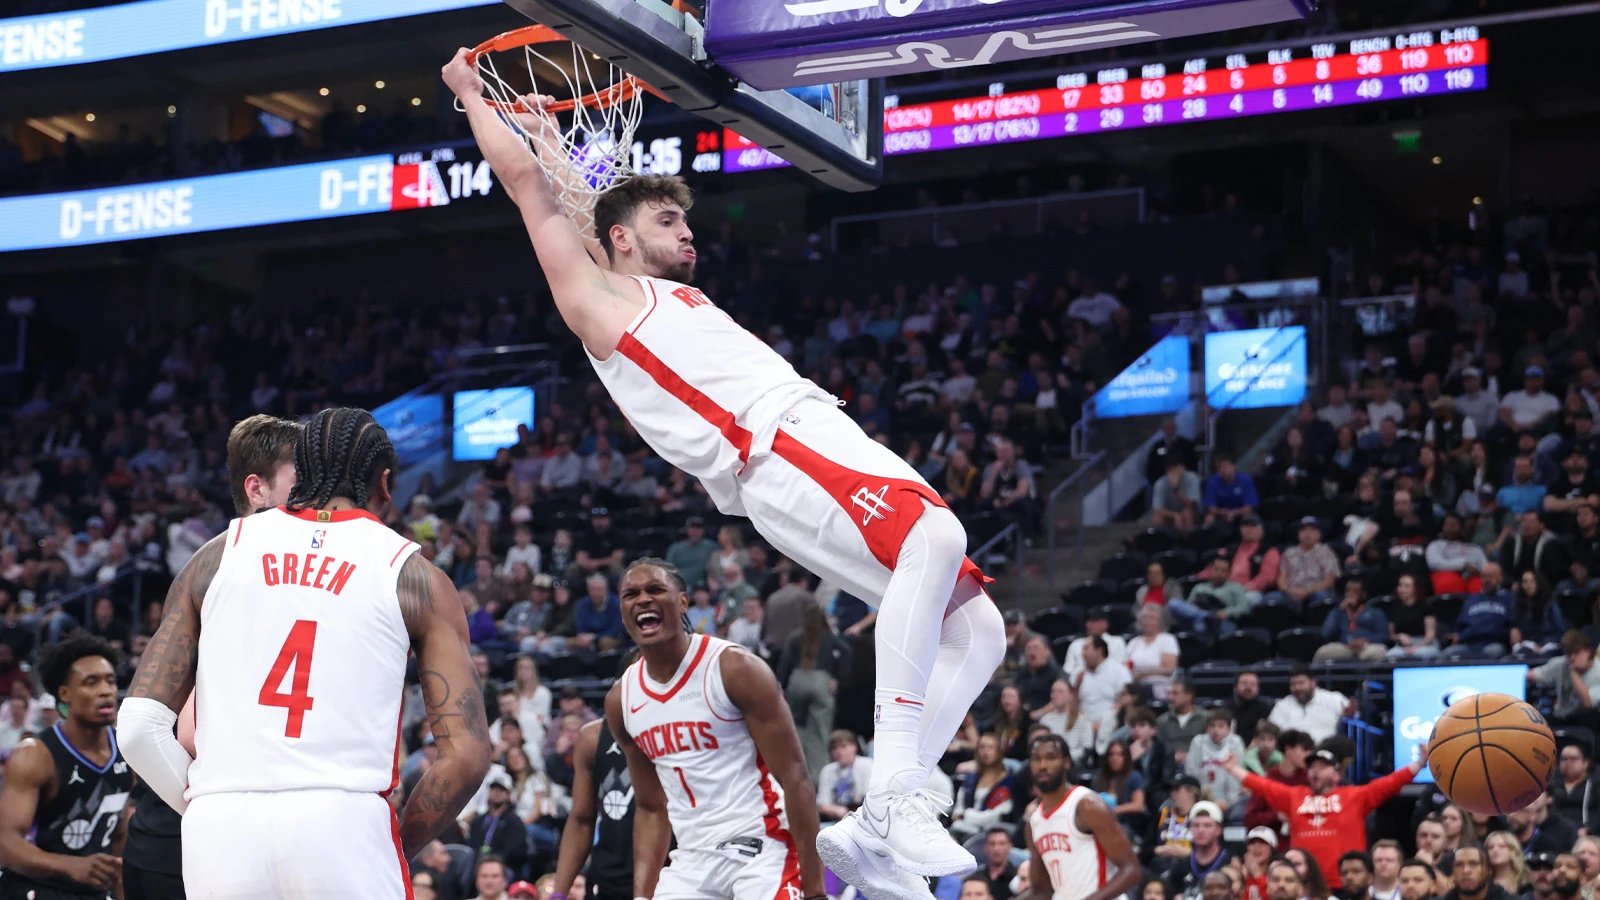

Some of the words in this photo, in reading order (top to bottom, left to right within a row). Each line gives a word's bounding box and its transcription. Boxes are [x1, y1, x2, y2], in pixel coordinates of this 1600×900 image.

[0, 17, 85, 64] ENSE
[1183, 58, 1207, 75] AST
[1225, 54, 1249, 70] STL
[1268, 48, 1292, 65] BLK
[1350, 37, 1391, 55] BENCH
[1061, 88, 1081, 109] 17
[1100, 84, 1125, 105] 33
[1140, 79, 1166, 100] 50
[1182, 74, 1208, 95] 24
[1229, 69, 1244, 90] 5
[1272, 65, 1287, 85] 5
[1315, 60, 1330, 80] 8
[1356, 54, 1383, 75] 36
[1399, 49, 1429, 70] 119
[1444, 44, 1474, 64] 110
[1064, 112, 1078, 132] 2
[1099, 107, 1125, 129] 29
[1142, 103, 1164, 124] 31
[1182, 98, 1208, 119] 28
[1229, 93, 1244, 113] 4
[1272, 88, 1287, 109] 5
[1312, 83, 1334, 104] 14
[1356, 77, 1384, 98] 49
[1399, 73, 1430, 95] 110
[1444, 68, 1474, 89] 119
[631, 136, 682, 176] 1:35
[447, 160, 493, 199] 114
[60, 187, 193, 239] D-FENSE
[262, 553, 356, 596] GREEN
[258, 619, 317, 738] 4
[673, 767, 696, 808] 1
[101, 814, 118, 847] 2
